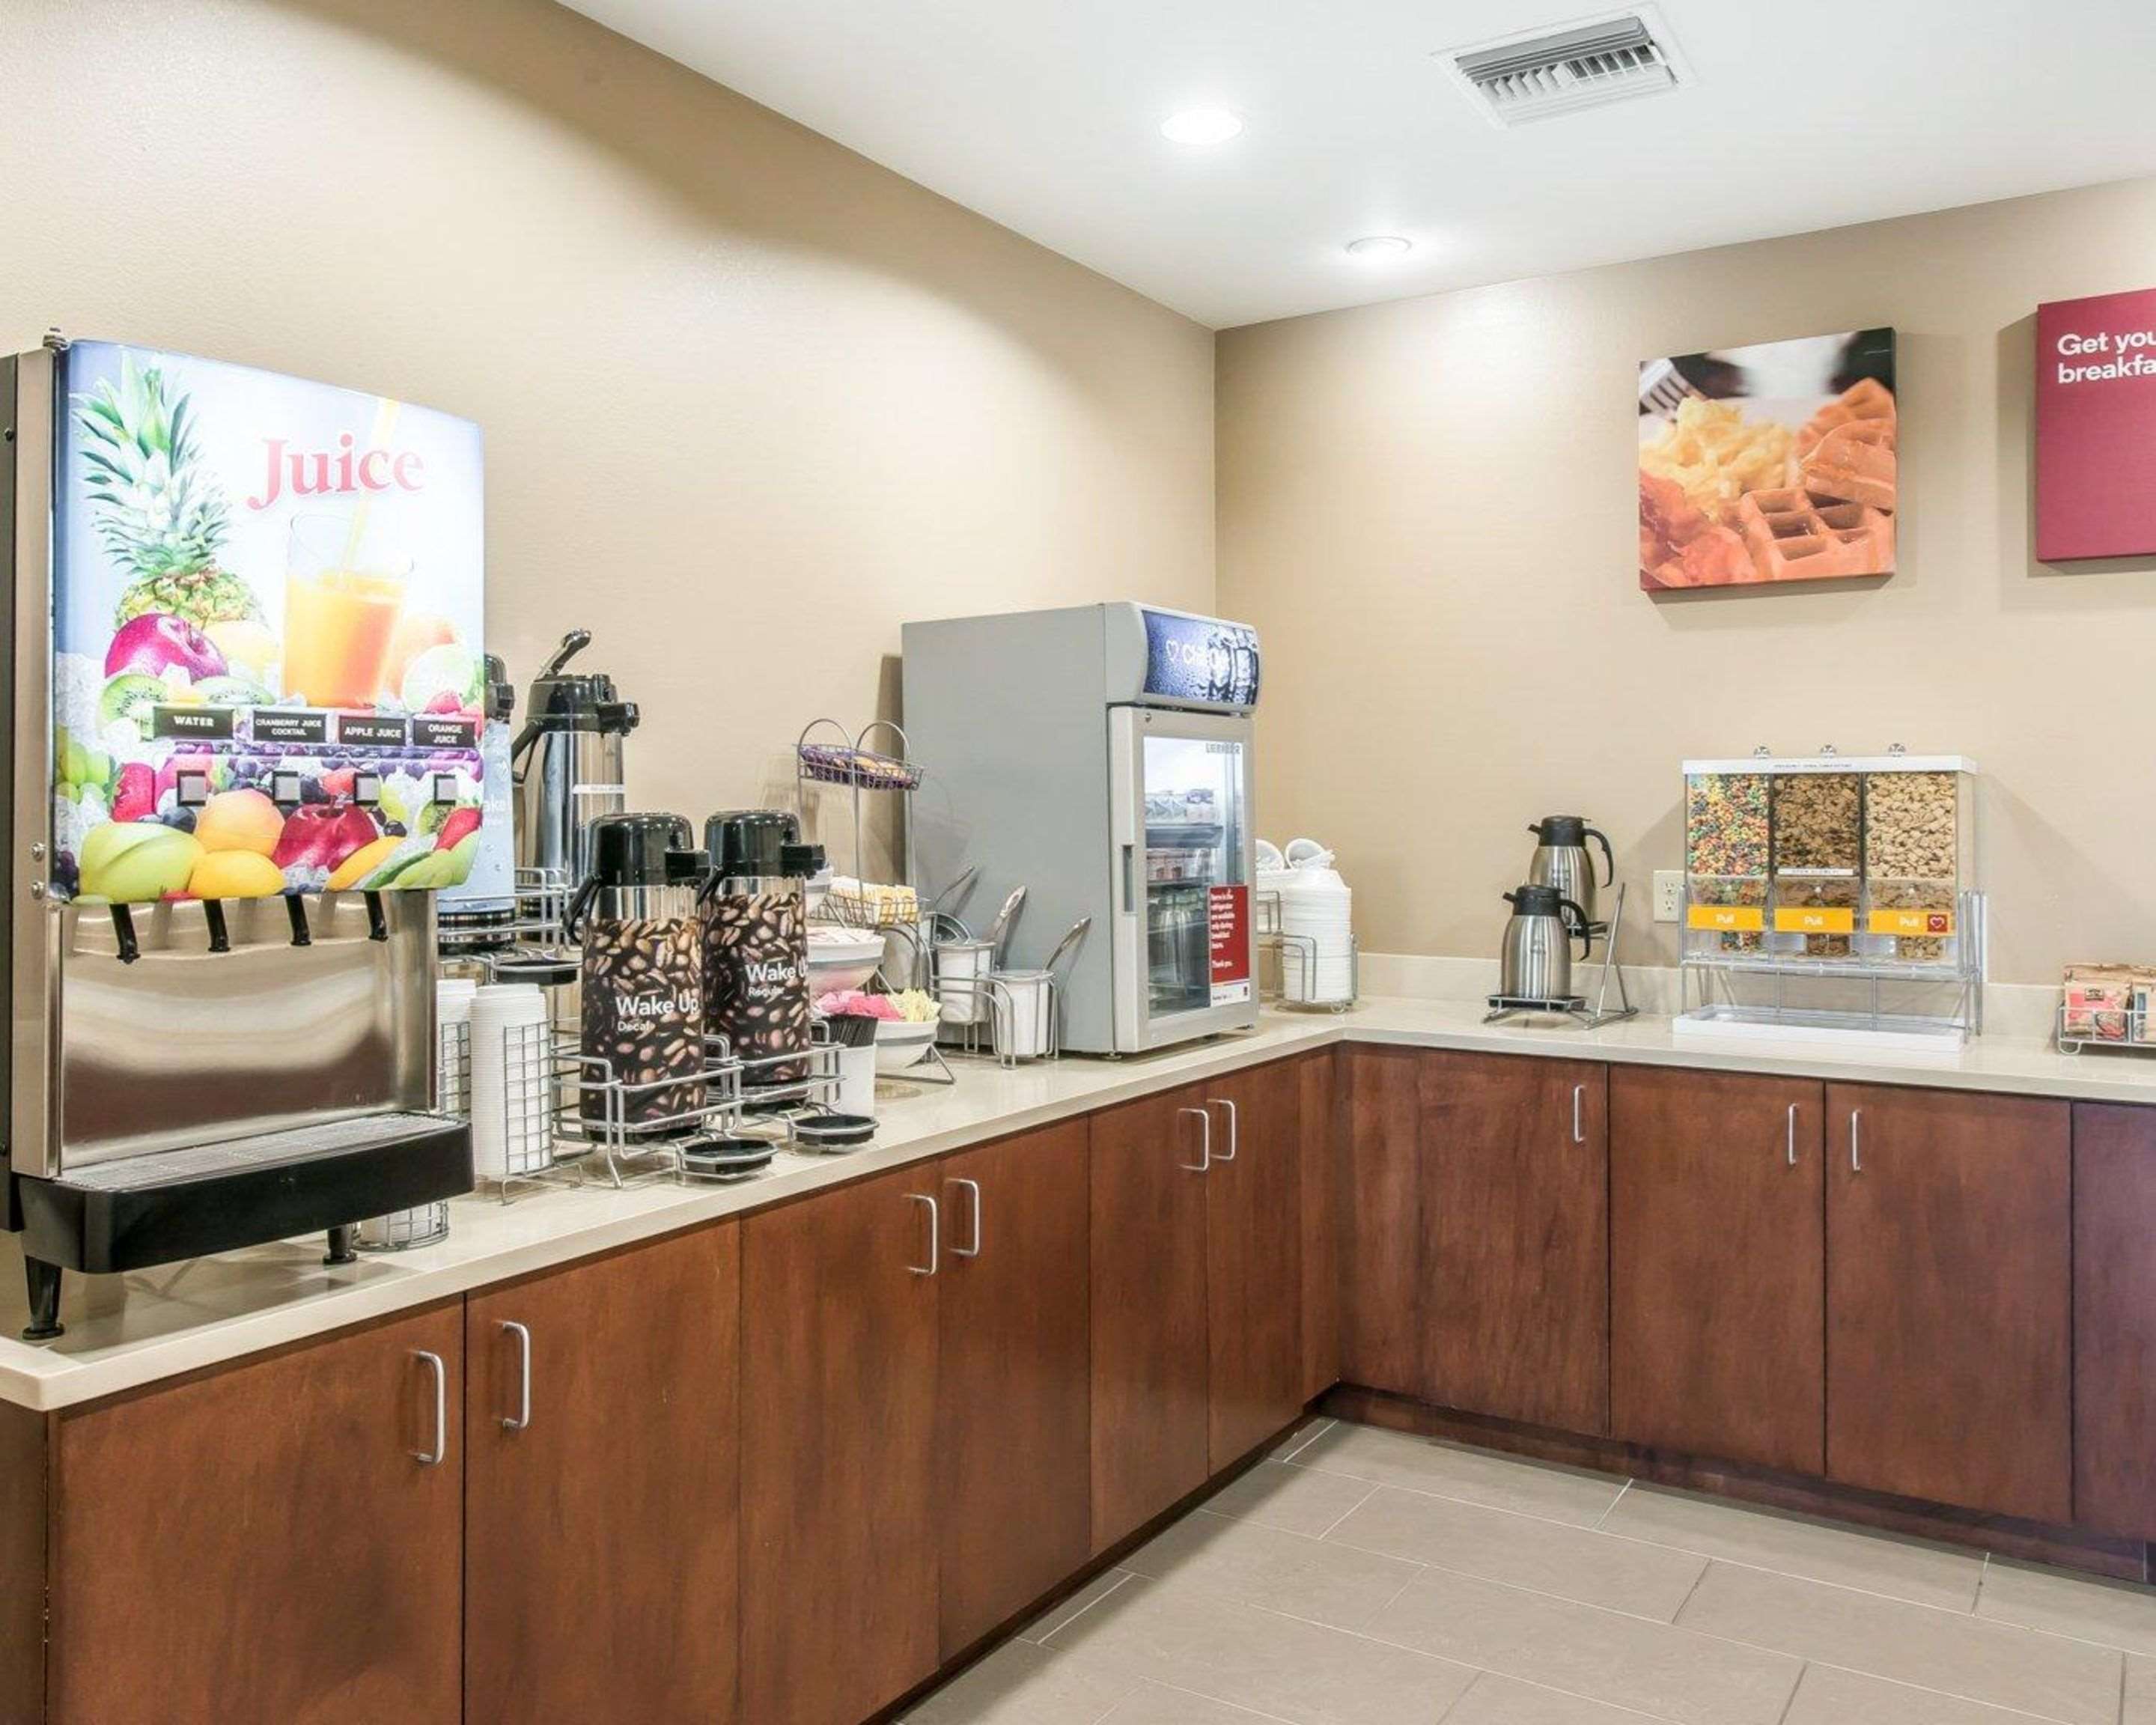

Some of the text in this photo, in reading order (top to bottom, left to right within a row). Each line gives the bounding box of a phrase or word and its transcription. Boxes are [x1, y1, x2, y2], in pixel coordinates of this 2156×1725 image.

[2057, 332, 2109, 356] Get
[2058, 354, 2156, 383] breakfa
[247, 433, 425, 511] Juice
[173, 715, 215, 728] WATER
[255, 718, 322, 728] CRANBERRY JUICE
[271, 728, 308, 736] COCKTAIL
[344, 726, 402, 739] APPLE JUICE
[427, 723, 463, 734] ORANGE
[433, 735, 457, 744] JUICE
[1716, 913, 1735, 924] Pull
[1804, 915, 1824, 925] Pull
[1899, 916, 1919, 927] Pull
[744, 962, 797, 982] Wake
[615, 992, 699, 1016] Wake Up
